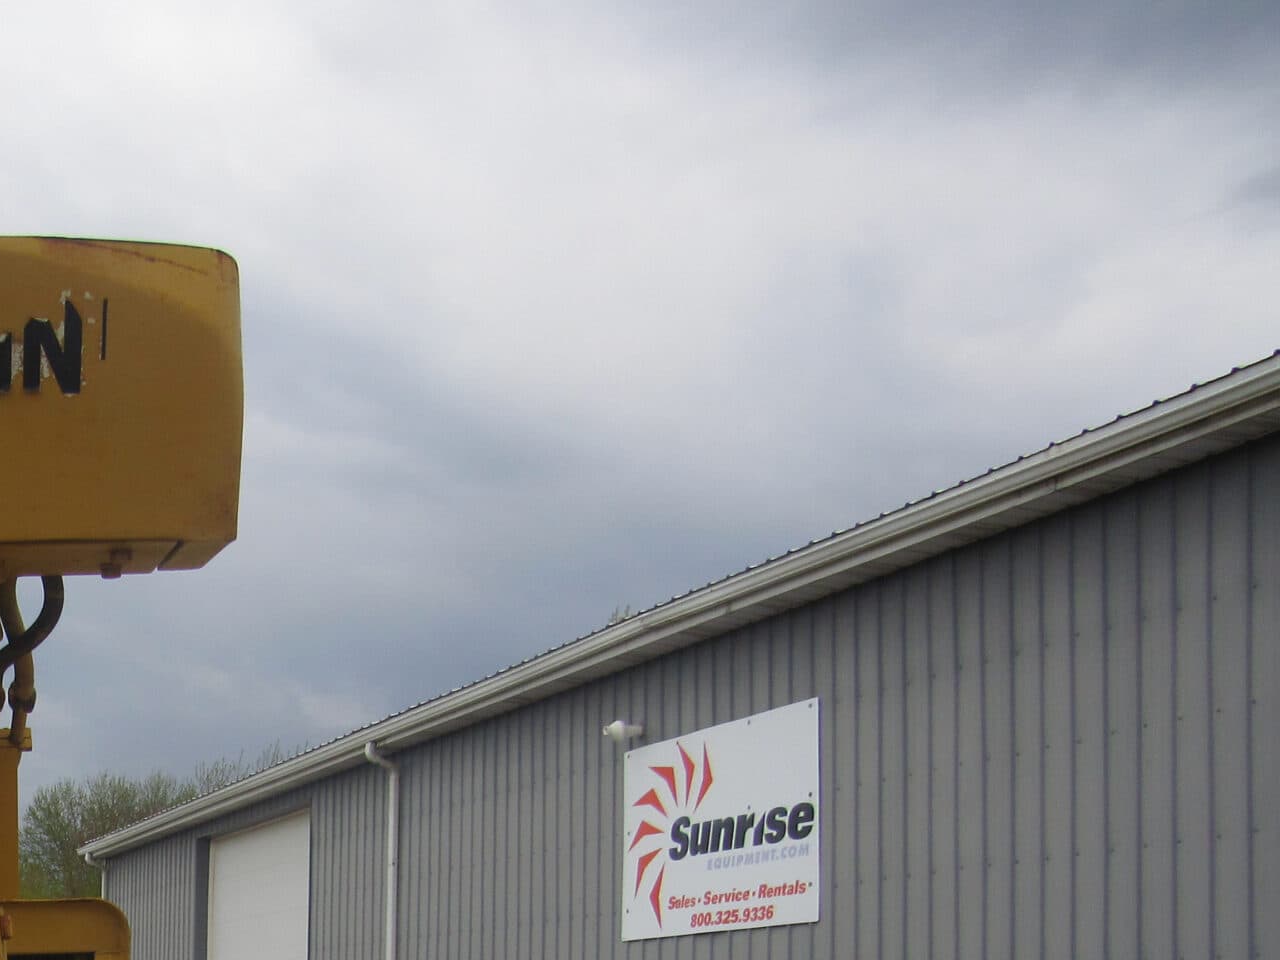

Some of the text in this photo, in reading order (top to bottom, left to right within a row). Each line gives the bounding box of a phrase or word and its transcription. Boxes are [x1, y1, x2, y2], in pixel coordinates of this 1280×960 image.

[669, 802, 815, 861] Sunrise
[707, 843, 810, 871] EQUIPMENT.COM
[668, 880, 807, 910] Sales Service Rentals
[690, 905, 774, 928] 800.325.9336
